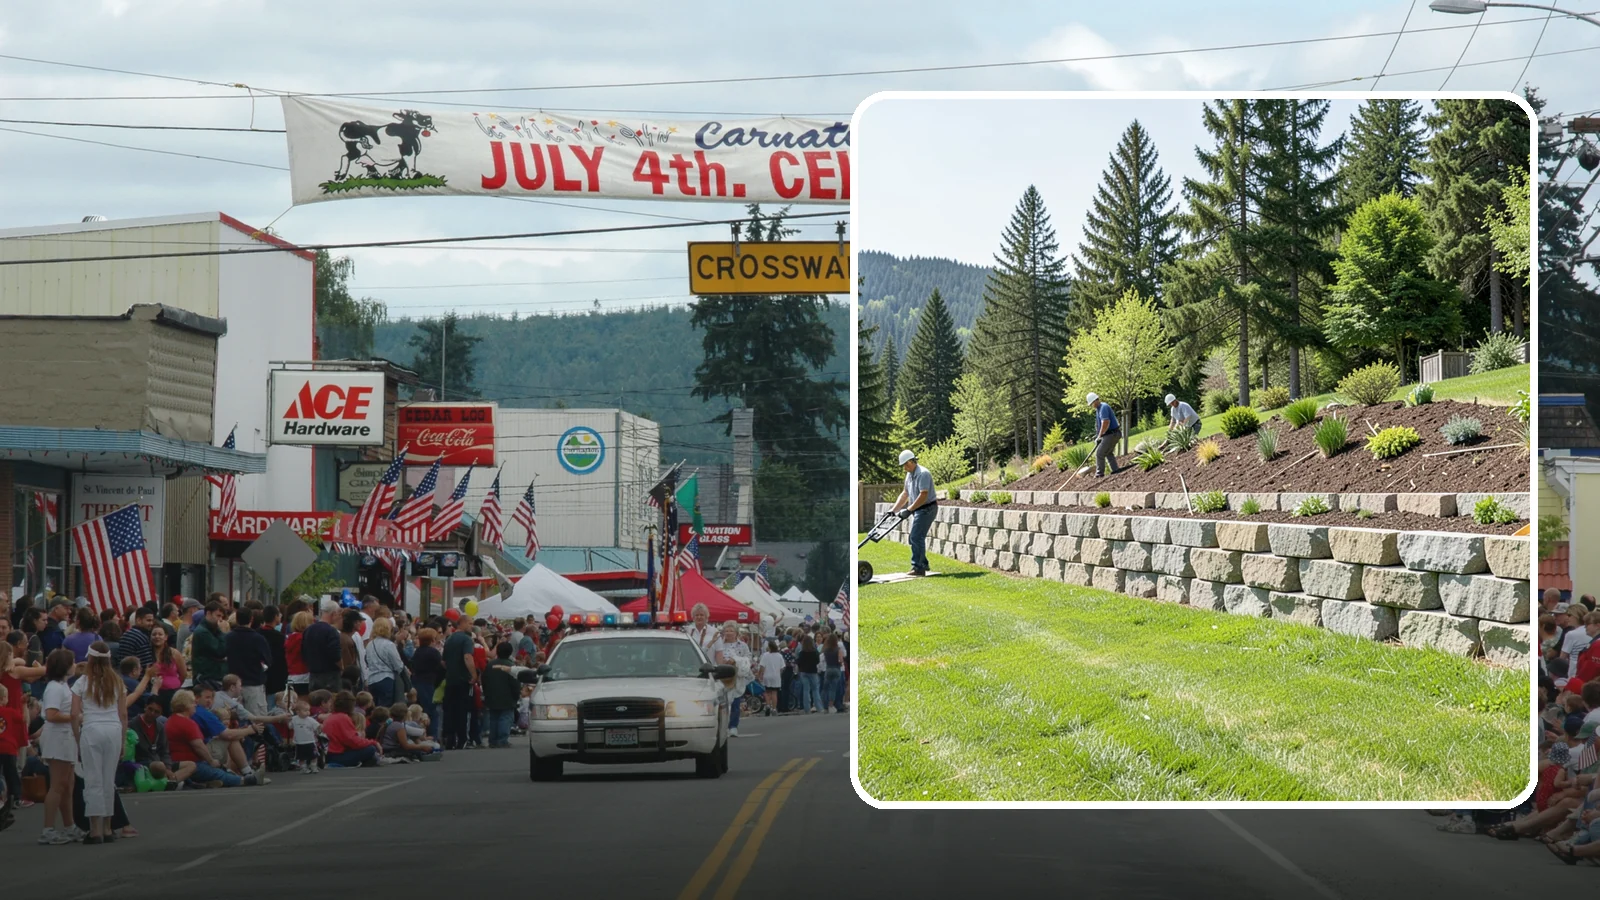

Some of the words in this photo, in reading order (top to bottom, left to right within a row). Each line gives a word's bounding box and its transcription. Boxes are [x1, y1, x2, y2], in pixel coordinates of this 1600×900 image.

[695, 121, 850, 149] Carnat
[481, 141, 605, 192] JULY
[632, 150, 746, 197] 4th.
[696, 254, 850, 281] CROSSWA
[283, 380, 374, 420] ACE
[405, 409, 453, 422] CEDAR
[284, 421, 371, 437] Hardware
[416, 428, 477, 447] Coca-Cola
[96, 485, 124, 495] Vincent
[126, 485, 136, 495] de
[138, 486, 155, 496] Paul
[688, 526, 742, 535] CRNATION
[699, 535, 731, 543] GLASS
